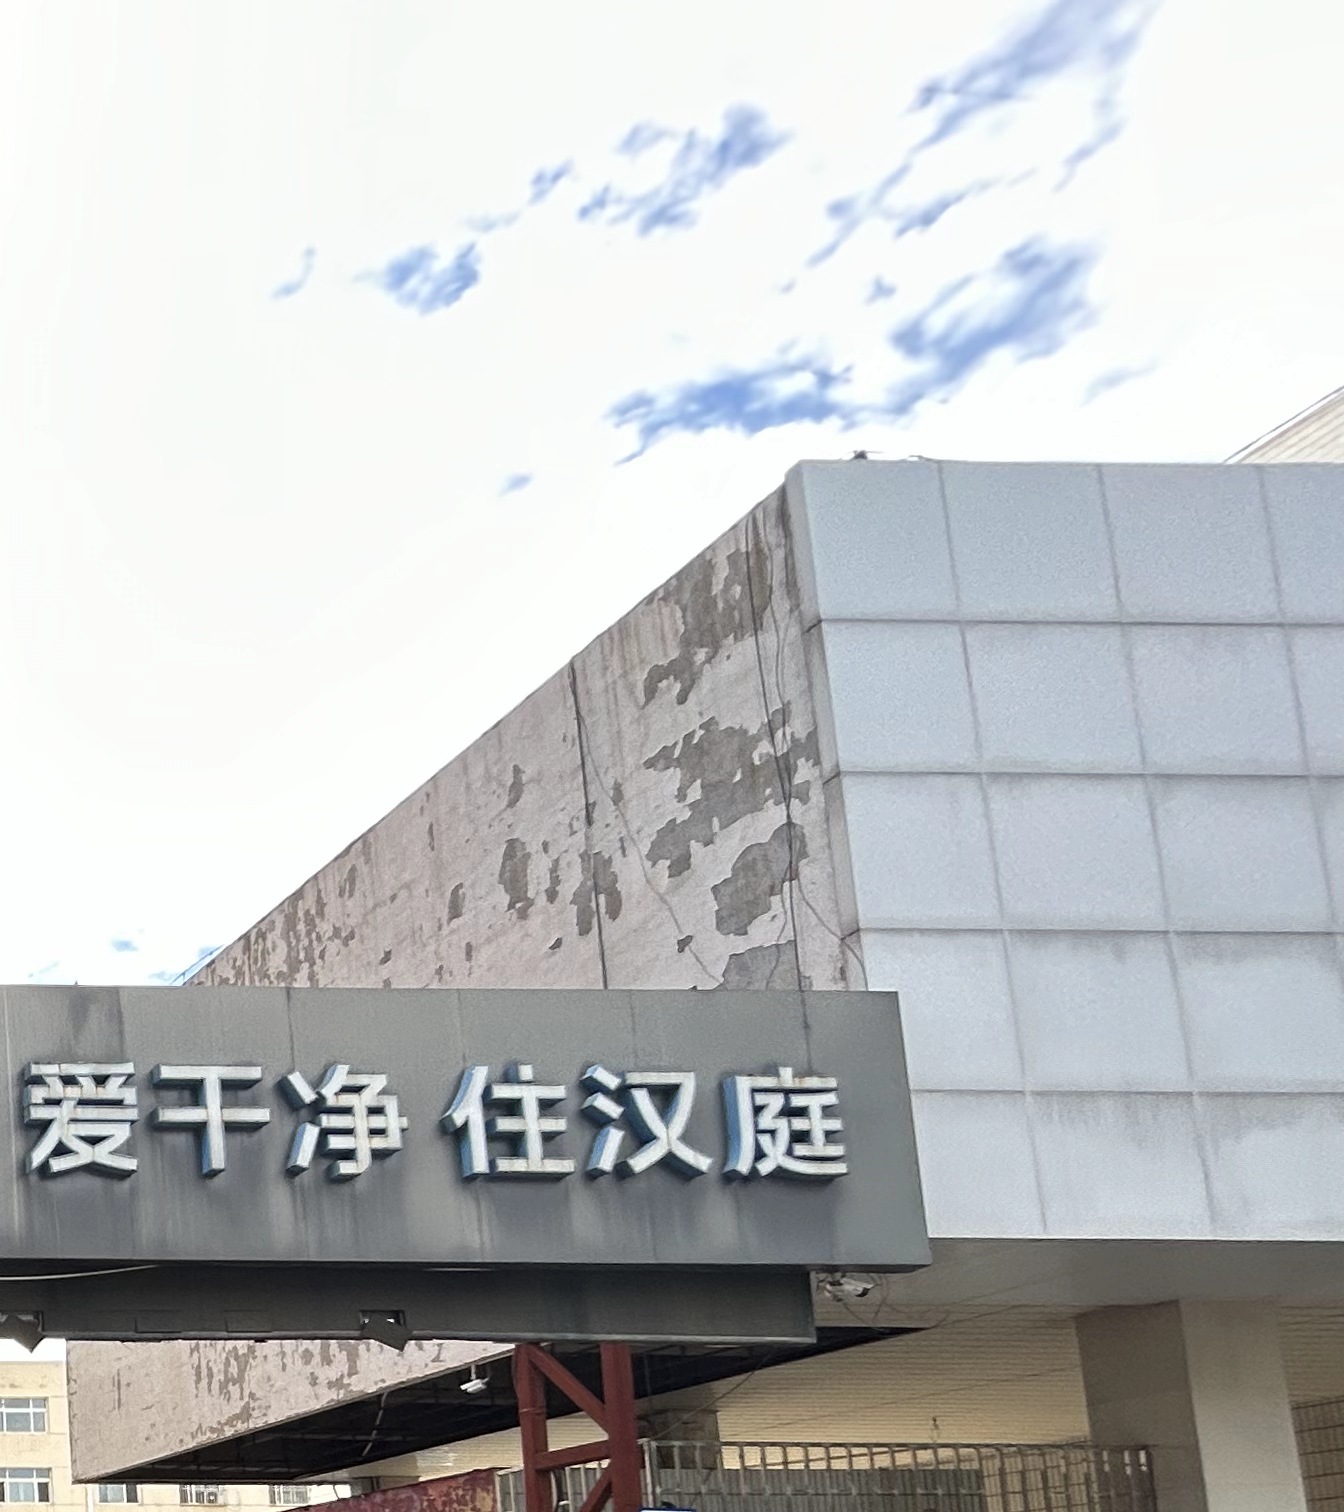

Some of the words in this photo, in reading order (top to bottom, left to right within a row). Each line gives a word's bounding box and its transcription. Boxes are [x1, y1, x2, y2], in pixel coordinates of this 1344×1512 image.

[23, 1060, 410, 1182] 爱干净
[441, 1062, 850, 1182] 住汉庭
